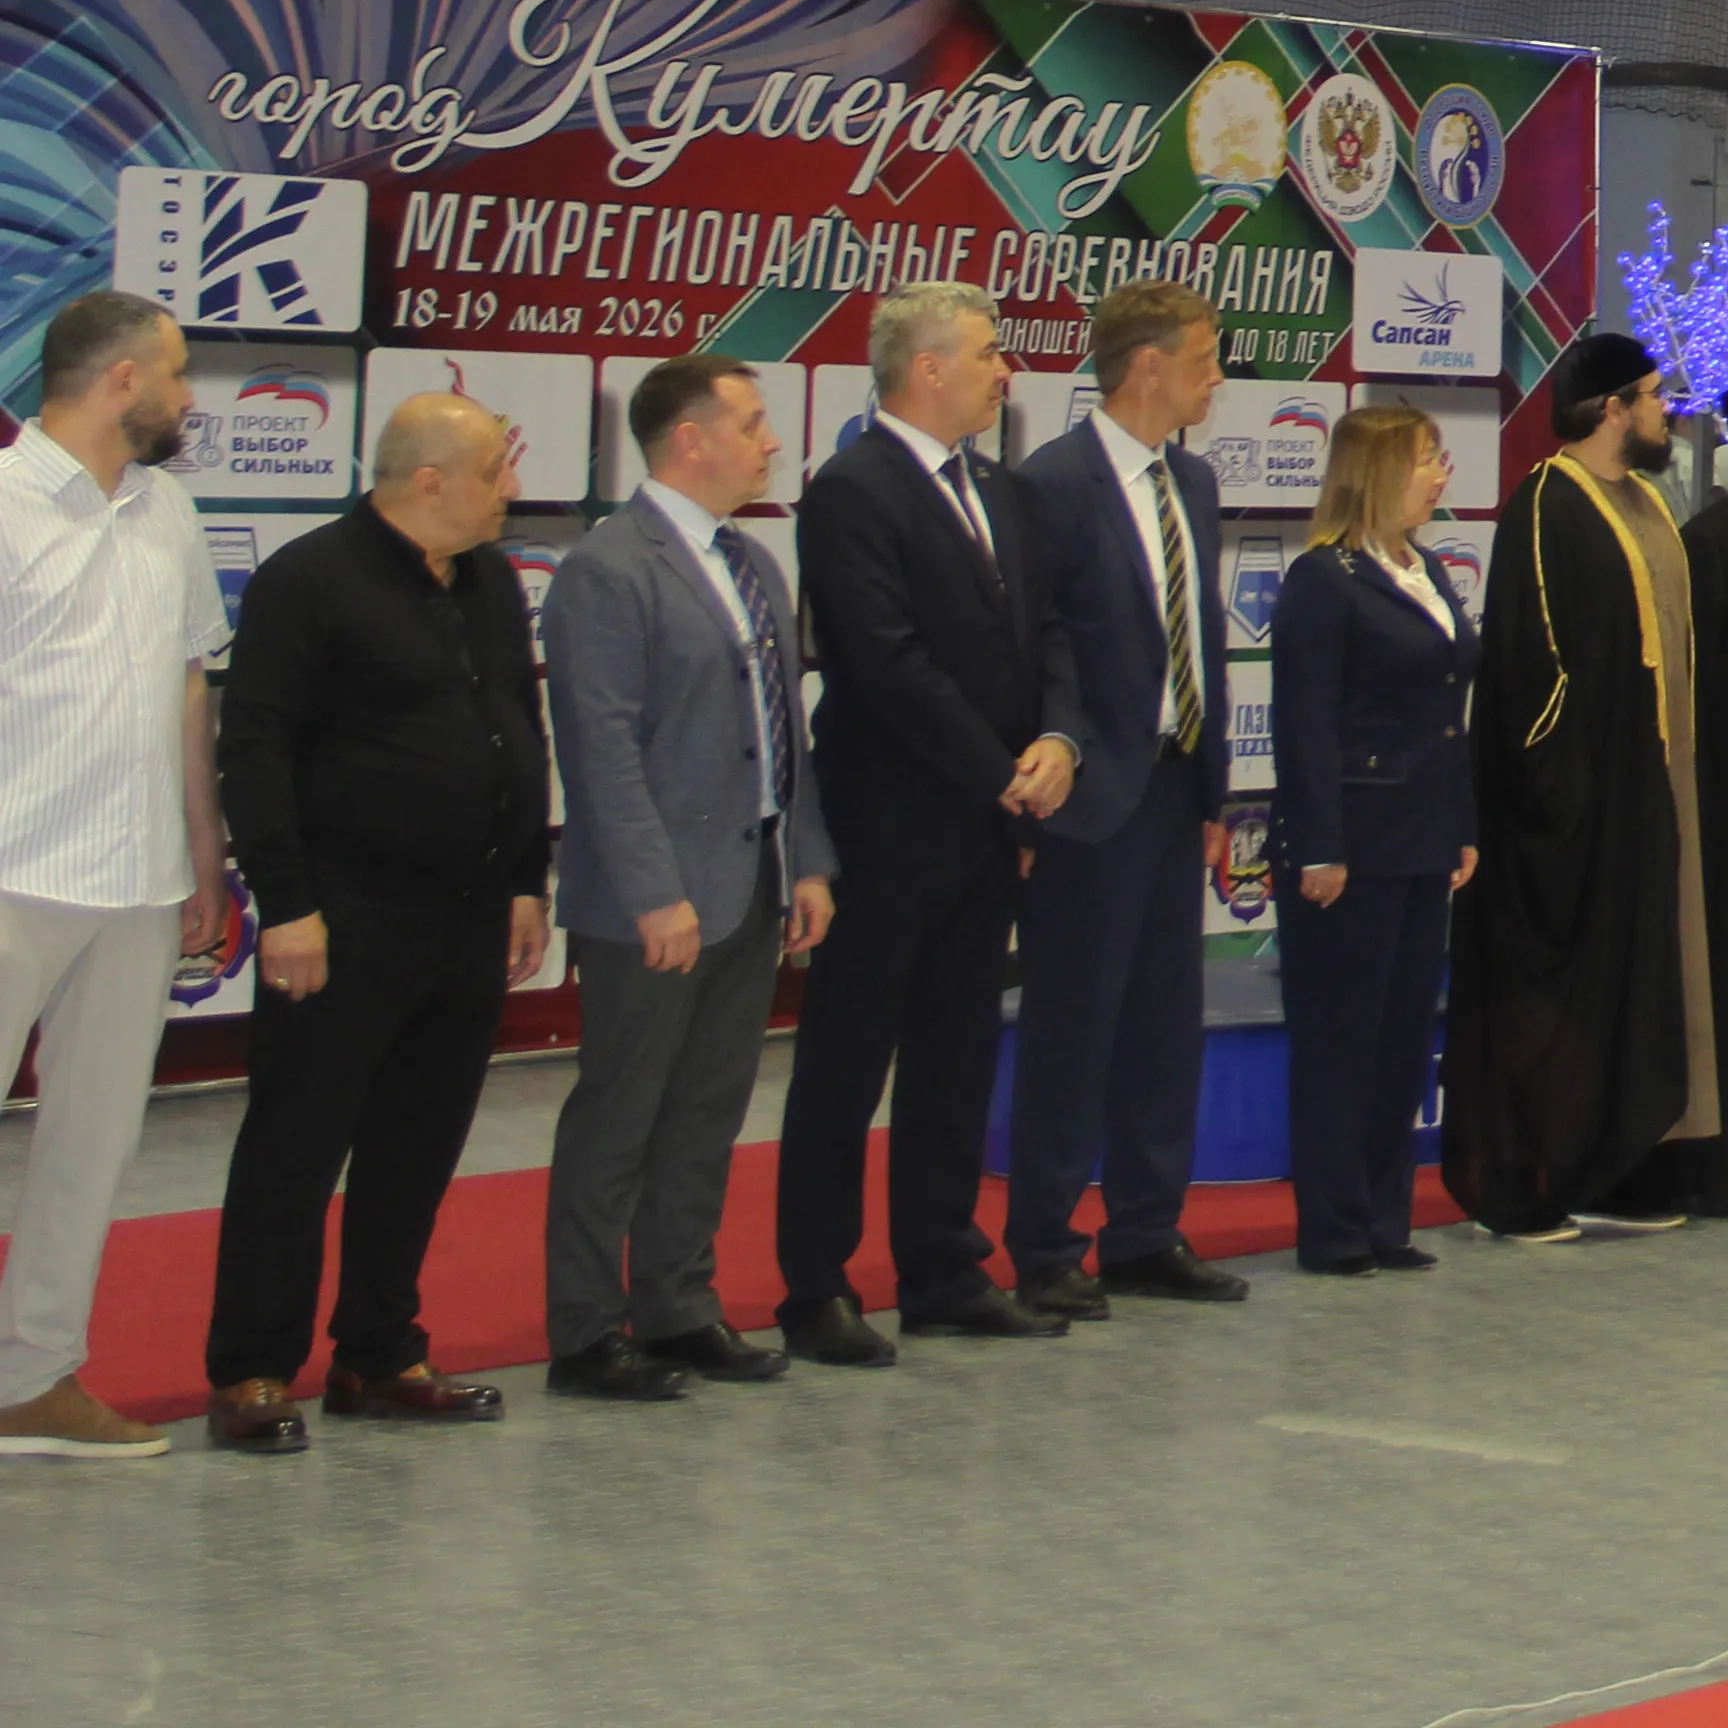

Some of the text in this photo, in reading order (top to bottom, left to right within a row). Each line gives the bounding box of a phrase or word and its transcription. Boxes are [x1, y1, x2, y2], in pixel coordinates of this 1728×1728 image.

[207, 47, 478, 174] город
[395, 190, 1334, 316] МЕЖРЕГИОНАЛЬНЫЕ СОРЕВНОВАНИЯ
[393, 287, 498, 332] 18-19
[509, 304, 583, 336] мая
[595, 295, 685, 340] 2026
[1371, 320, 1452, 346] Сапсан
[1226, 328, 1260, 365] ДО
[1266, 329, 1290, 363] 18
[1292, 330, 1336, 365] ЛЕТ
[1418, 350, 1475, 369] АРЕНА
[232, 414, 309, 432] ПРОЕКТ
[231, 436, 309, 453] ВЫБОР
[230, 457, 336, 474] СИЛЬНЫХ
[1266, 456, 1316, 470] ВЫБОР
[1266, 474, 1324, 488] СИЛЬНЫ
